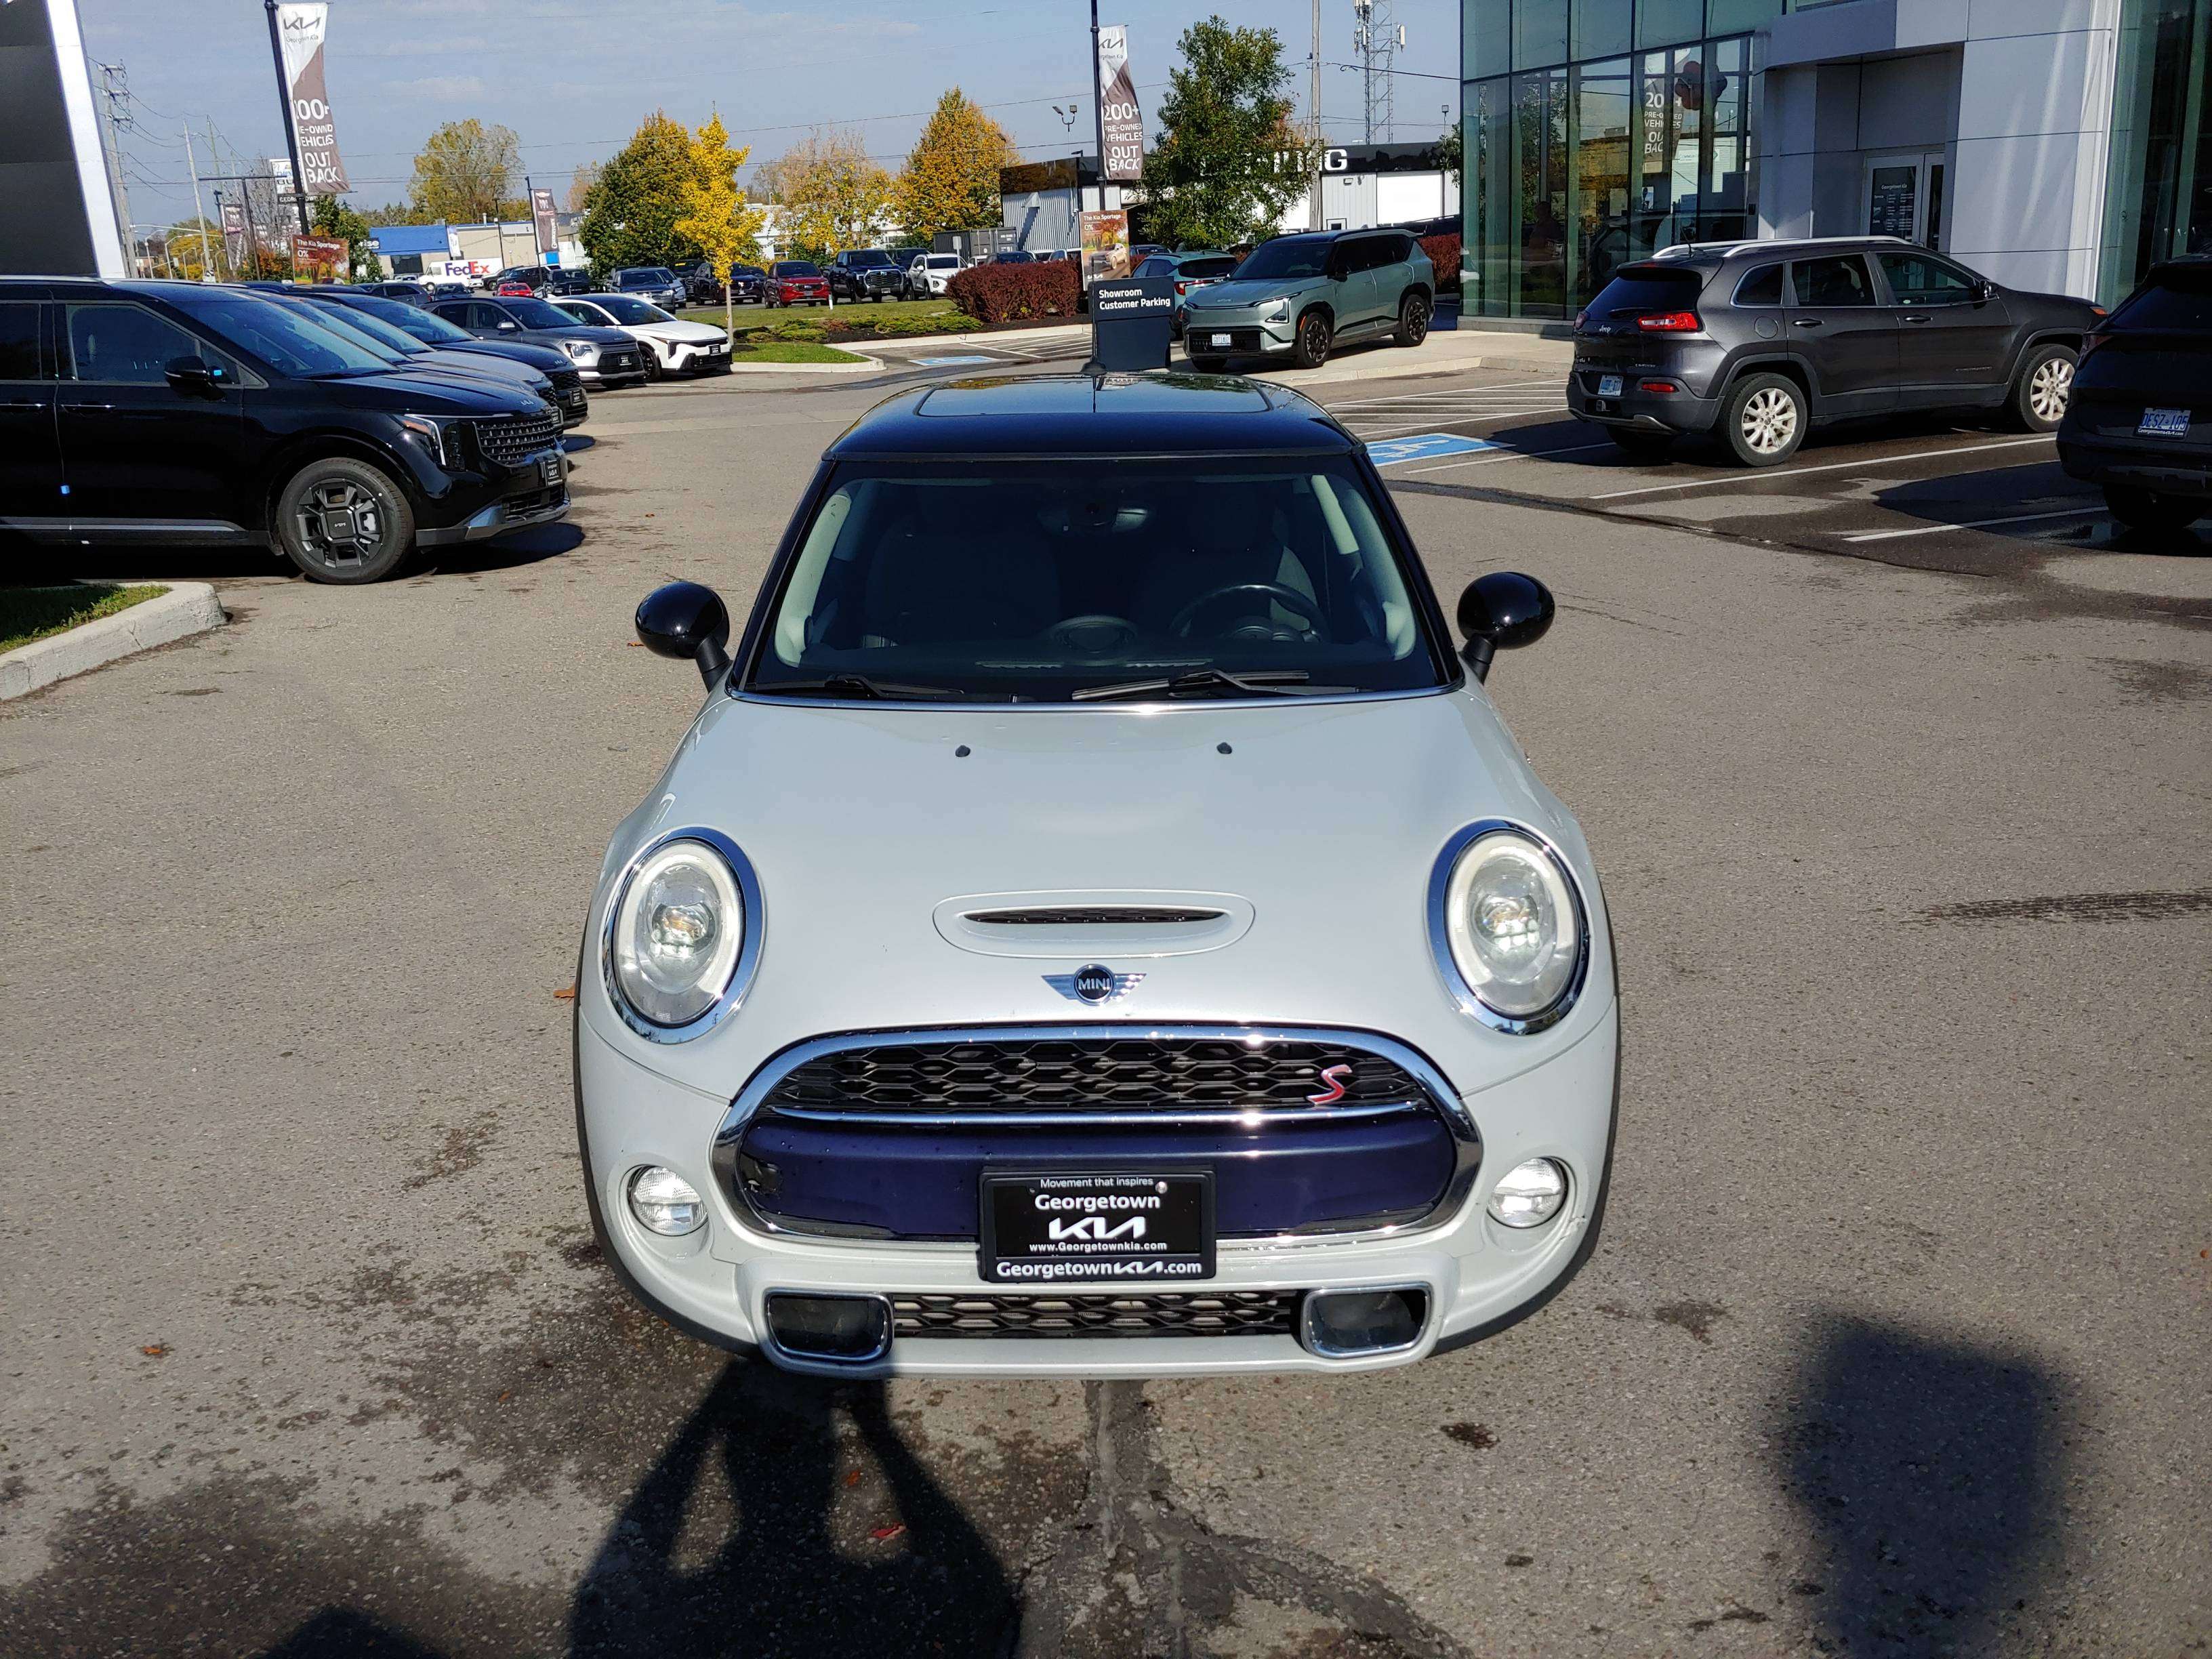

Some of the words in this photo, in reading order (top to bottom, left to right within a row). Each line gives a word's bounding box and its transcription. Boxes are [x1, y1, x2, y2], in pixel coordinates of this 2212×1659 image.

[1645, 92, 1682, 108] 20+
[1104, 102, 1139, 121] 200+
[1105, 123, 1142, 132] PRE-OWNED
[1105, 131, 1143, 142] VEHICLES
[1111, 145, 1139, 159] OUT
[305, 151, 330, 167] OUT
[1109, 158, 1140, 171] BACK
[306, 167, 341, 184] BACK
[316, 241, 340, 250] Sportage
[298, 249, 309, 258] 0%
[445, 261, 491, 276] FedEx
[1099, 289, 1143, 298] Showroom
[1099, 300, 1139, 310] Customer
[1141, 297, 1171, 308] Parking
[1599, 325, 1612, 334] Jeep
[1078, 978, 1110, 990] MINI
[1307, 1063, 1353, 1105] S
[1040, 1179, 1092, 1189] Movement
[1095, 1178, 1113, 1187] that
[1116, 1177, 1153, 1187] inspires
[1035, 1194, 1160, 1212] Georgetown
[1049, 1216, 1147, 1240] KIA
[1029, 1242, 1168, 1253] www.Georgetownkia.com
